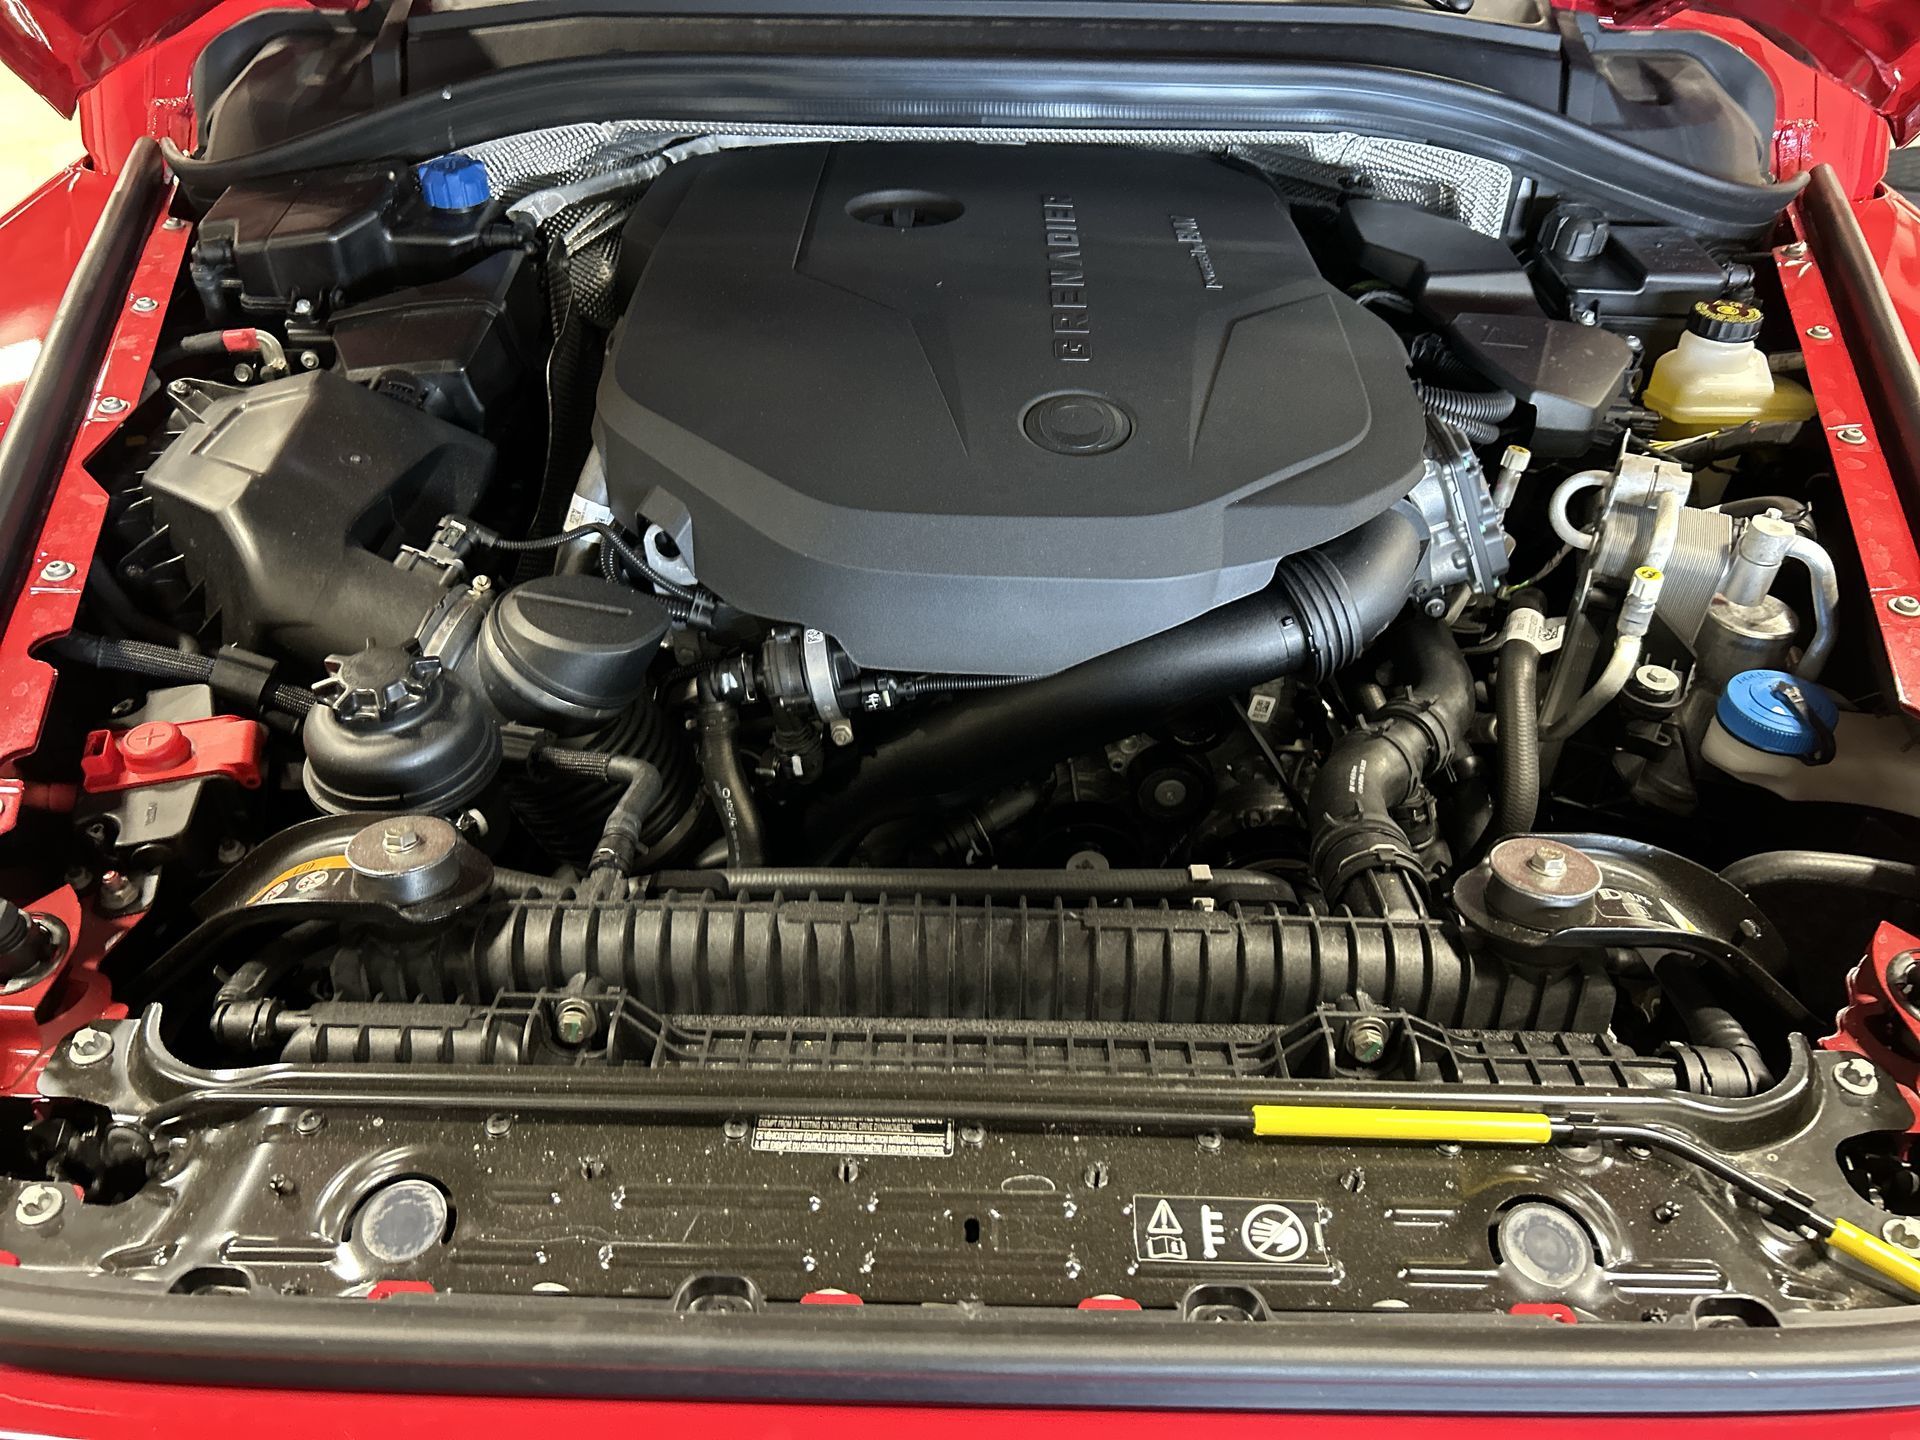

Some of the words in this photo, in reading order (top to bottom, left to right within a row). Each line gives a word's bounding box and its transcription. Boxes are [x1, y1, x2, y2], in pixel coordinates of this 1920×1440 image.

[1044, 194, 1092, 361] GRENADIER
[758, 1119, 777, 1127] EXEMPT
[777, 1119, 792, 1128] FROM
[801, 1120, 821, 1129] TESTING
[821, 1121, 829, 1129] ON
[859, 1122, 873, 1131] DRIVE
